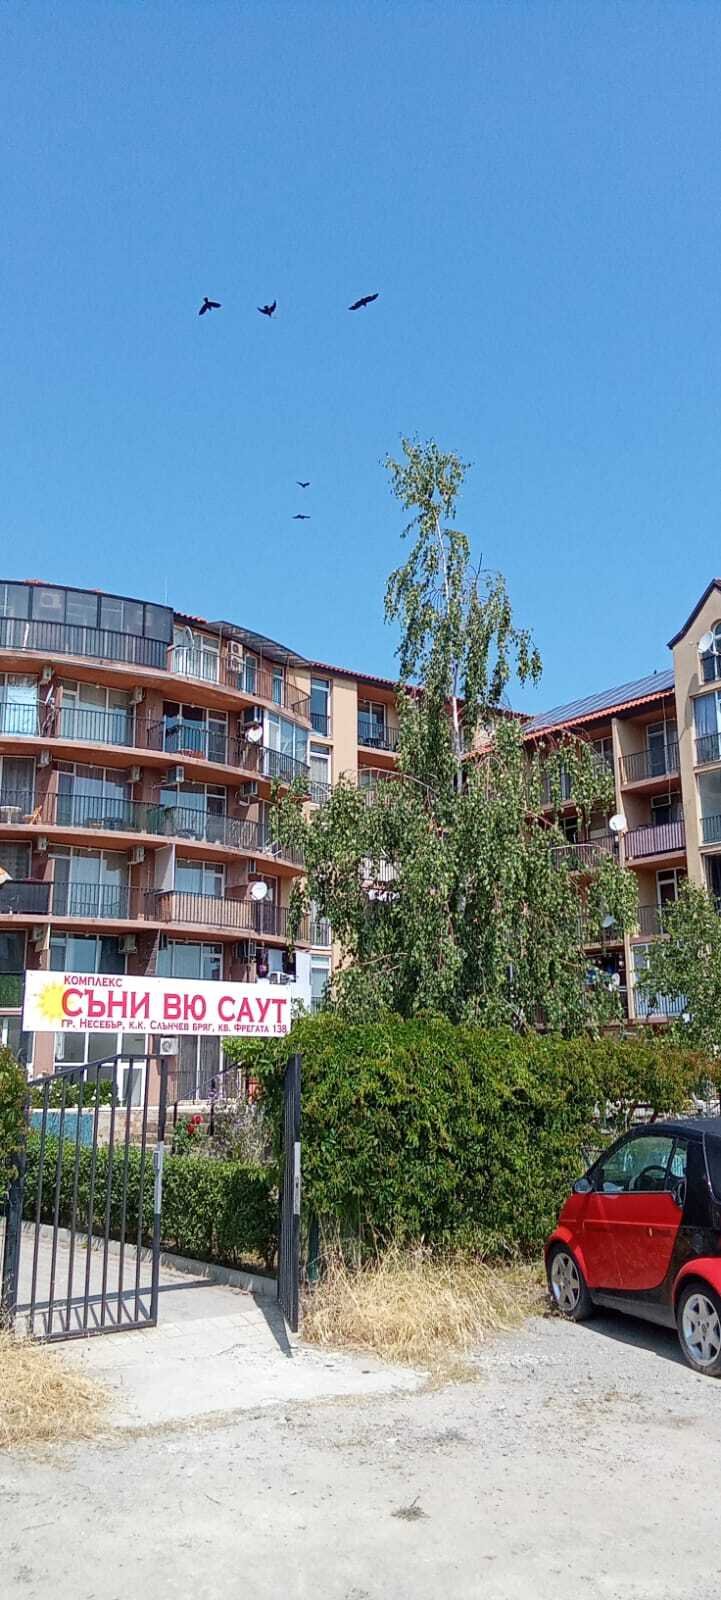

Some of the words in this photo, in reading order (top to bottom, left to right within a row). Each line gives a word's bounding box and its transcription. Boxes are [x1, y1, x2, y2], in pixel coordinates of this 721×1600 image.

[64, 975, 123, 987] КОМПЛЕКС
[62, 988, 151, 1019] СЪНИ
[163, 993, 207, 1021] ВЮ
[218, 996, 287, 1024] САУТ
[80, 1018, 126, 1030] НЕСЕБЪР,
[150, 1021, 189, 1031] СЛЪНЧЕВ
[234, 1022, 270, 1033] ФРЕГАТА
[273, 1024, 288, 1033] 138
